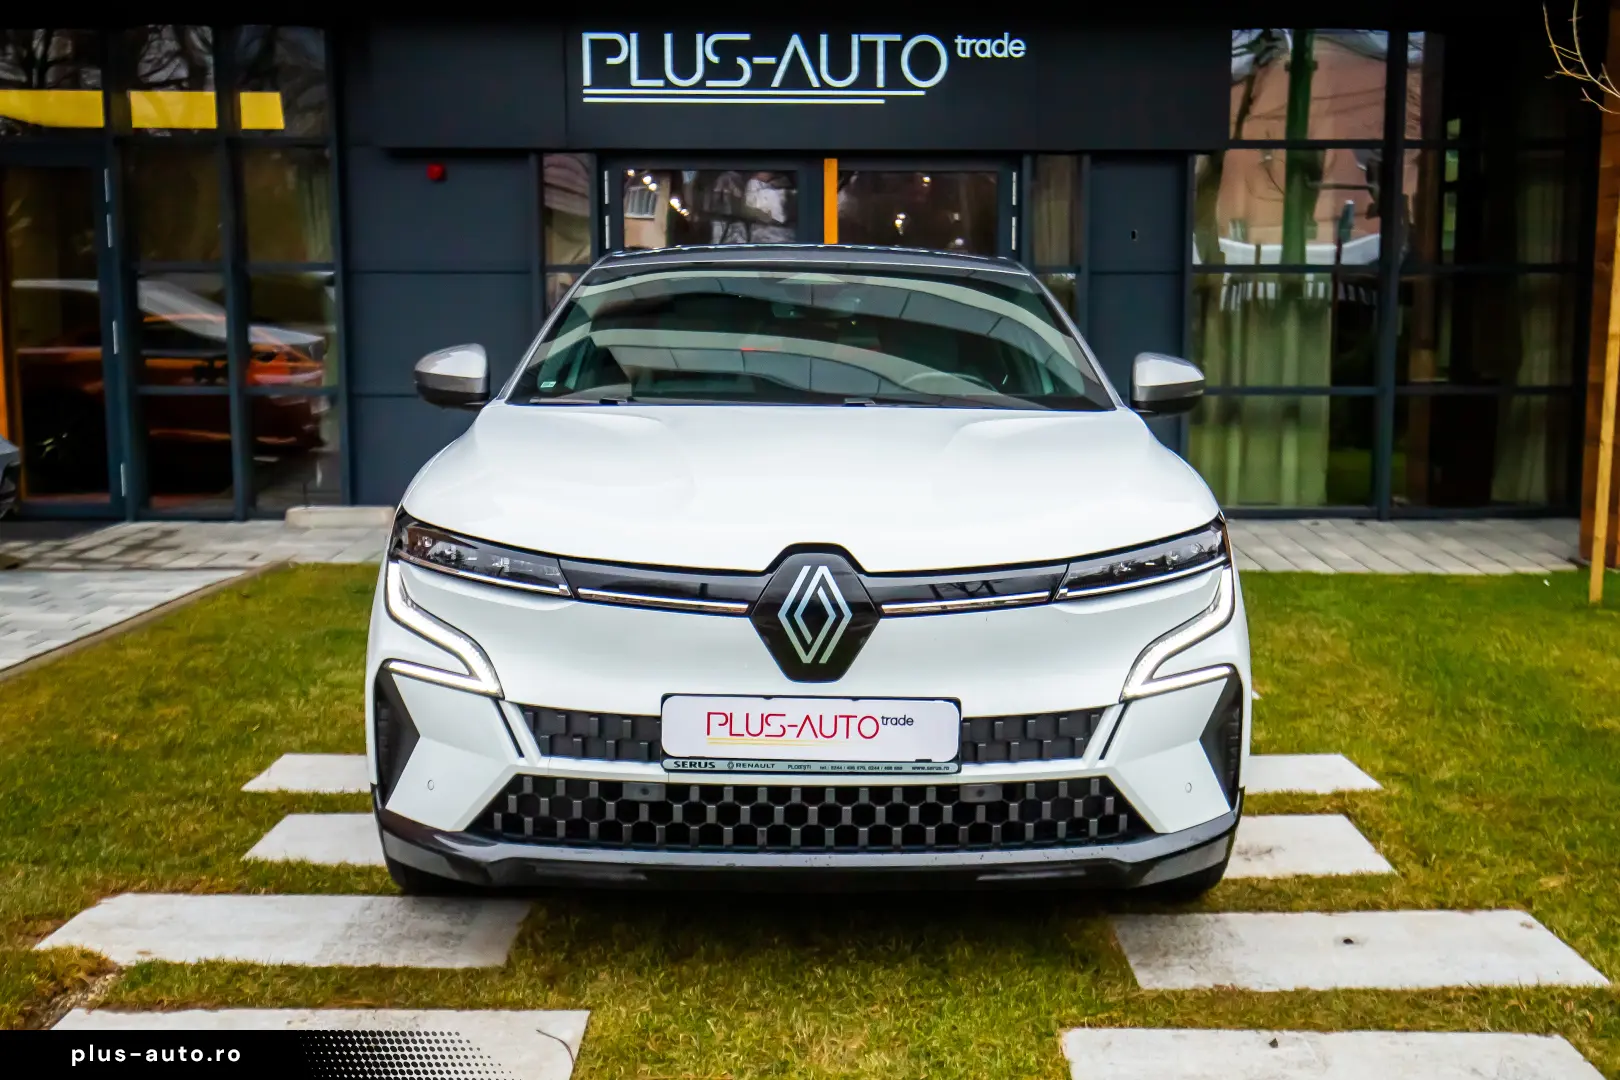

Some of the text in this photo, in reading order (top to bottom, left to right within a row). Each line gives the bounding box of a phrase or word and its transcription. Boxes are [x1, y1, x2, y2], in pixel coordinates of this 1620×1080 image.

[581, 32, 1026, 88] PLUS-AUTO trade
[706, 711, 914, 740] PLUS-AUTO trade
[673, 760, 716, 769] SERUS
